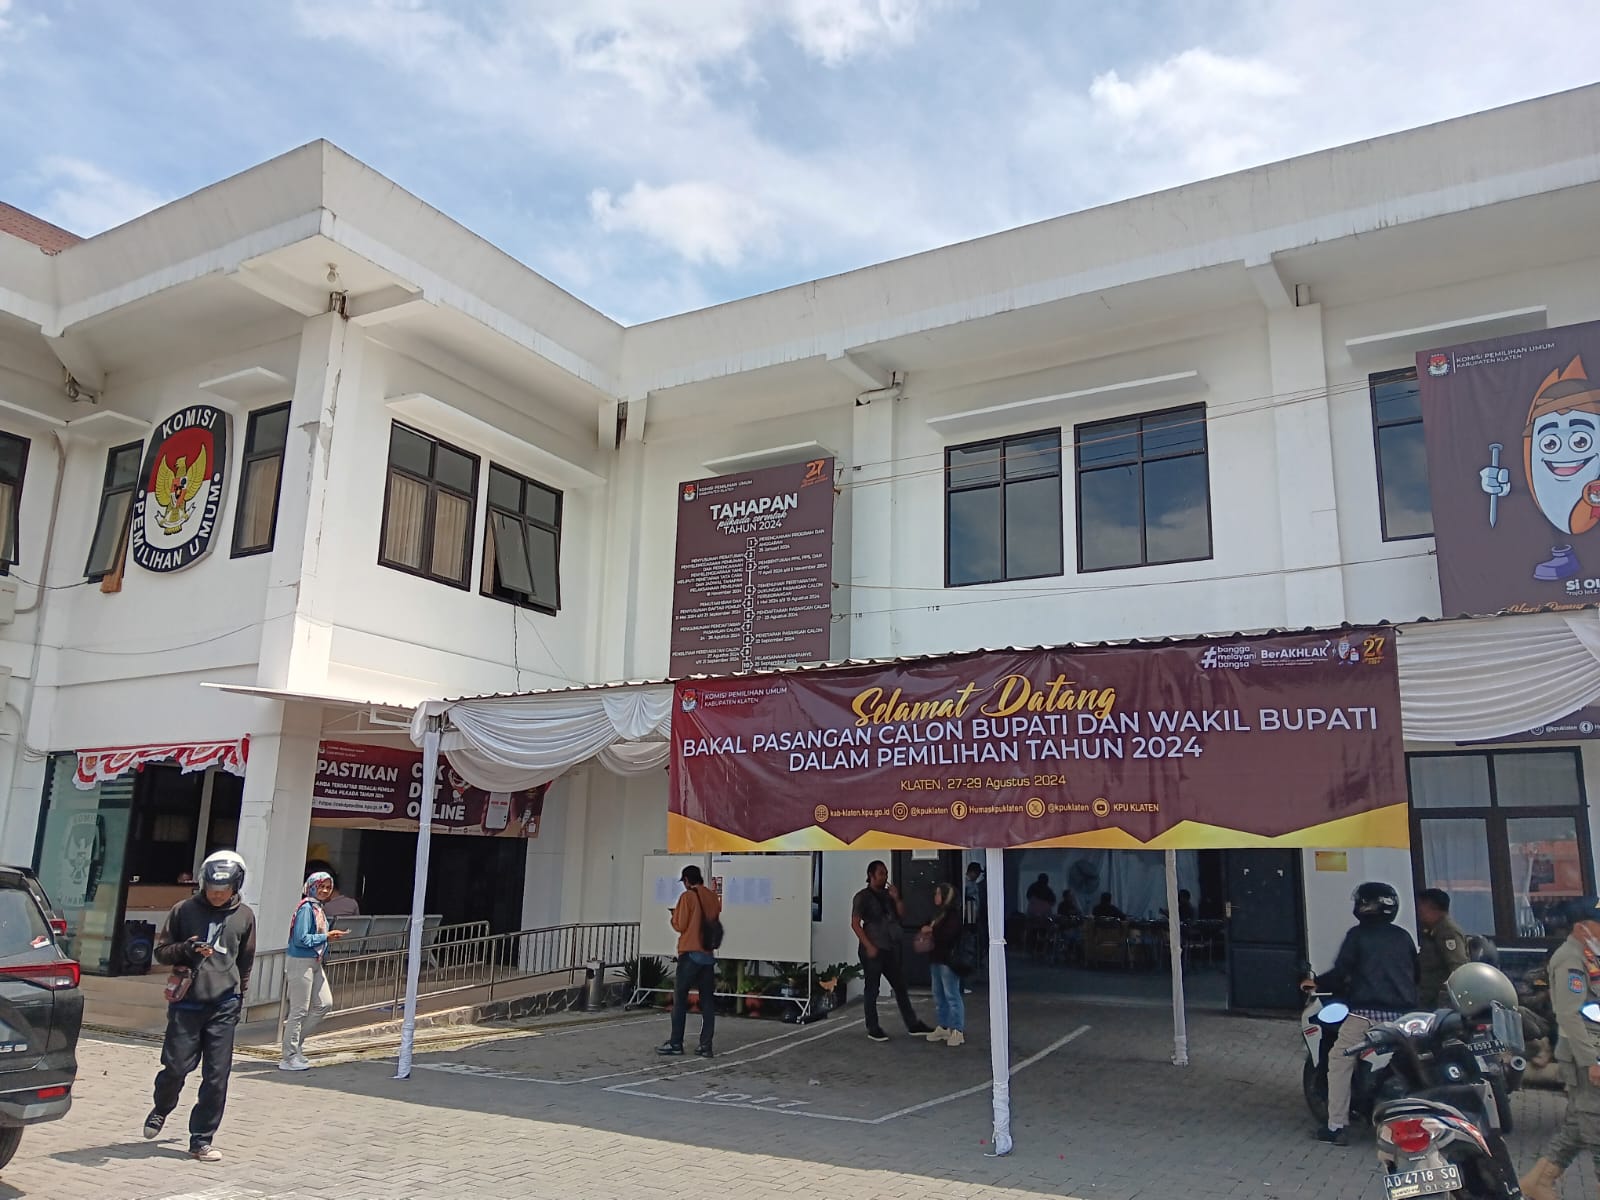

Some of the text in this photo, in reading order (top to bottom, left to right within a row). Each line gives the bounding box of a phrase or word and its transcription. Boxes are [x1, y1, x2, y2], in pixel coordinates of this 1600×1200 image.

[1457, 343, 1555, 363] KOMISI PEMILIHAN UMUM
[1457, 354, 1522, 368] KABUPATEN KLATEN
[162, 409, 217, 439] KOMISI
[806, 460, 825, 479] 27
[710, 492, 798, 520] TAHAPAN
[133, 484, 221, 569] PEMILIHAN UMUM
[724, 520, 782, 535] TAHUN 2024
[1566, 579, 1580, 591] Si
[1218, 652, 1256, 661] melayani
[1261, 647, 1328, 659] BerAKHLAK
[1364, 638, 1385, 658] 27
[1218, 660, 1250, 669] bangsa
[705, 687, 787, 700] KOMISI PEMILIHAN UMUM
[851, 674, 1116, 727] Selamat Datang
[683, 707, 1377, 757] BAKAL PASANGAN CALON BUPATI DAN WAKIL BUPATI
[789, 735, 1203, 772] DALAM PEMILIHAN TAHUN 2024
[316, 759, 399, 782] PASTIKAN
[411, 762, 446, 780] CK
[408, 782, 443, 800] DT
[900, 774, 1066, 791] KLATEN, 27-29 Agustus 2024
[406, 801, 466, 820] OLINE
[910, 807, 948, 816] @kpuklaten
[969, 804, 1024, 814] Humaskpuklaten
[1047, 803, 1089, 813] @kpuklaten
[1113, 804, 1128, 812] KPU
[1130, 803, 1159, 812] KLATEN
[1386, 1176, 1401, 1188] AD
[1405, 1170, 1434, 1184] 4718
